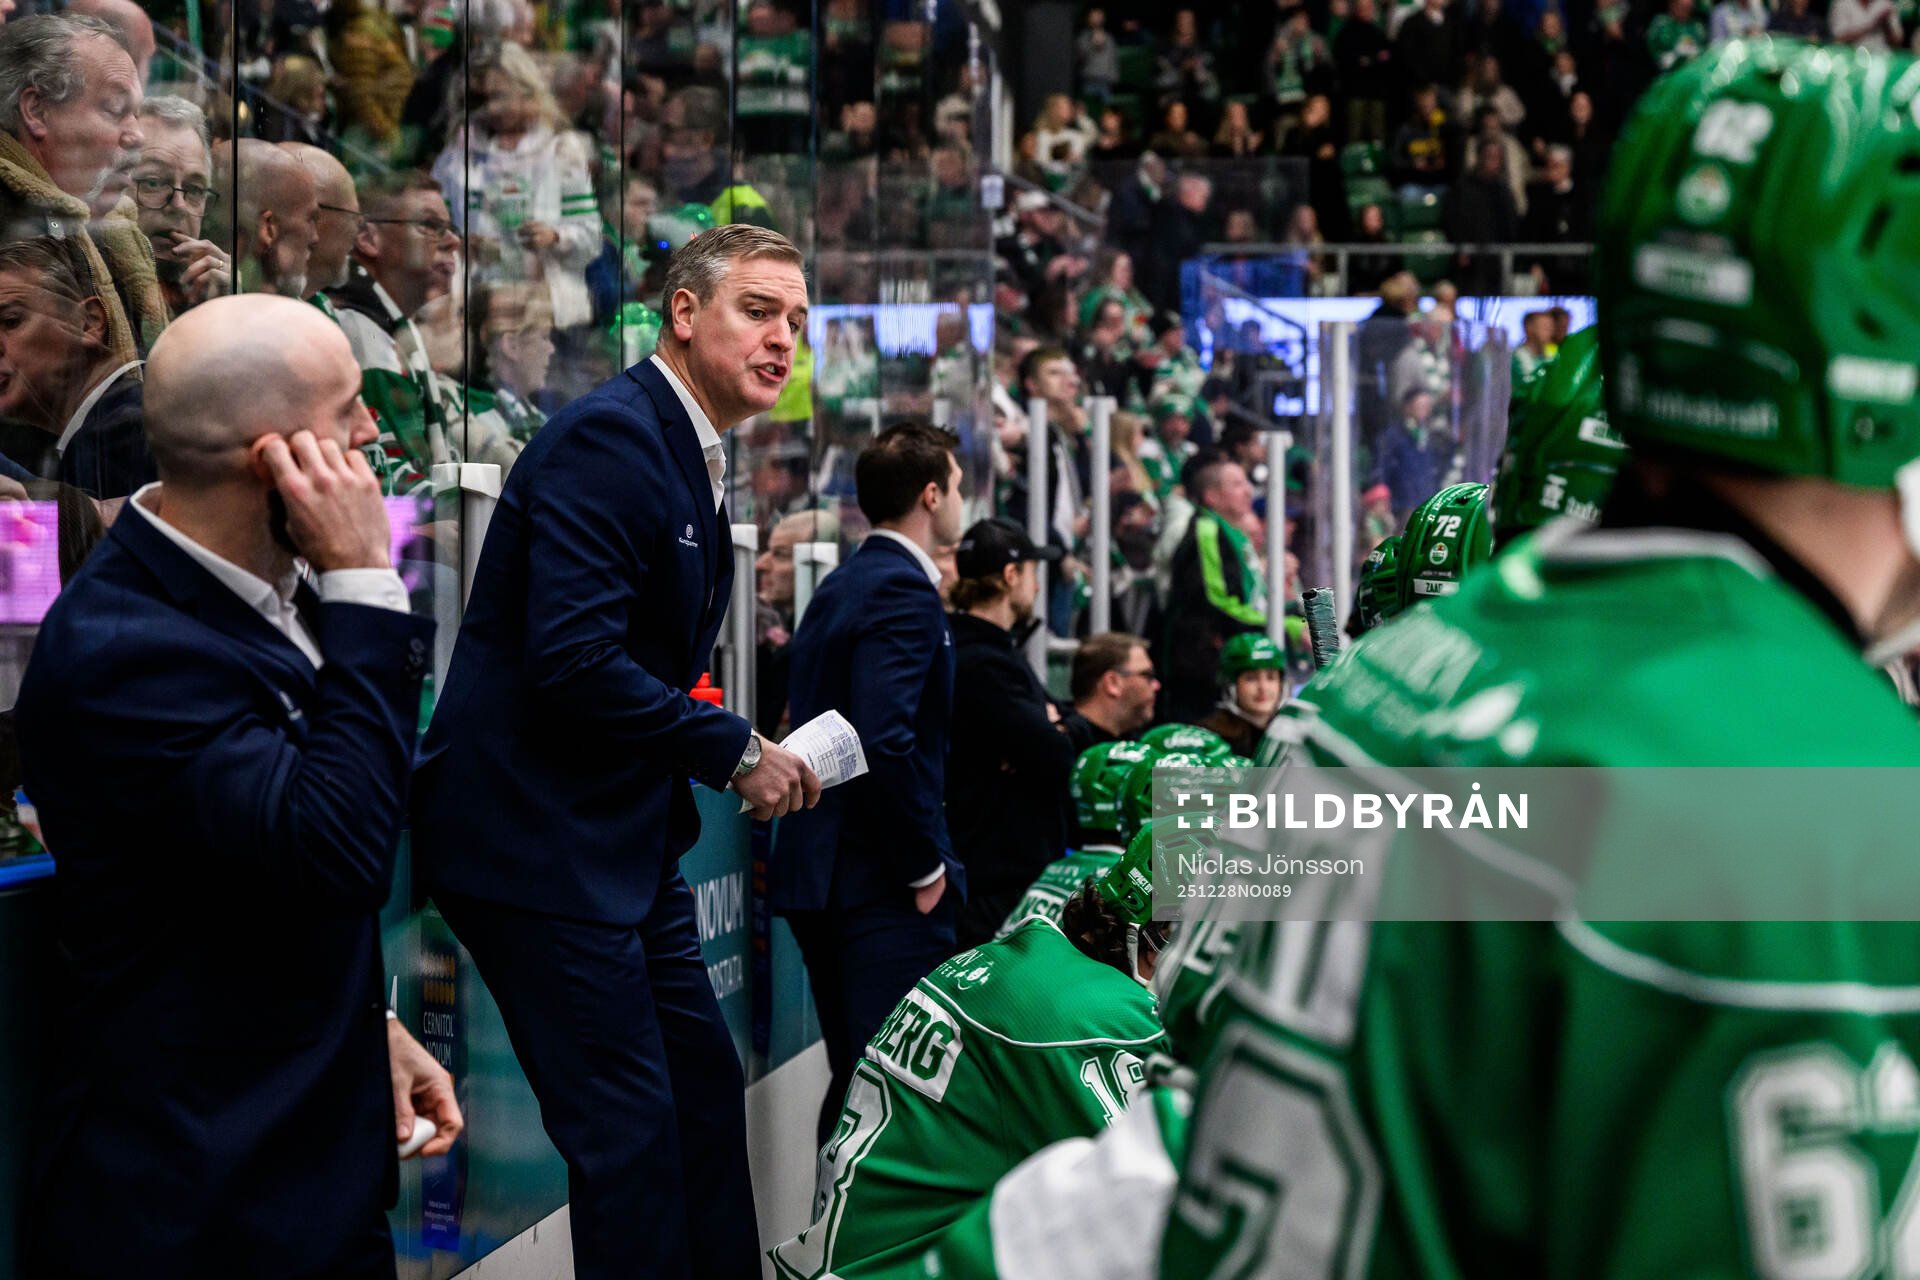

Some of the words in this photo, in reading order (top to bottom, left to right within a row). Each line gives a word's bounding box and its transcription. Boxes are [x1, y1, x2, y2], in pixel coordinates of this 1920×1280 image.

[1432, 514, 1462, 538] 72
[697, 871, 744, 944] NOVUM
[423, 1011, 454, 1038] CERNITOL
